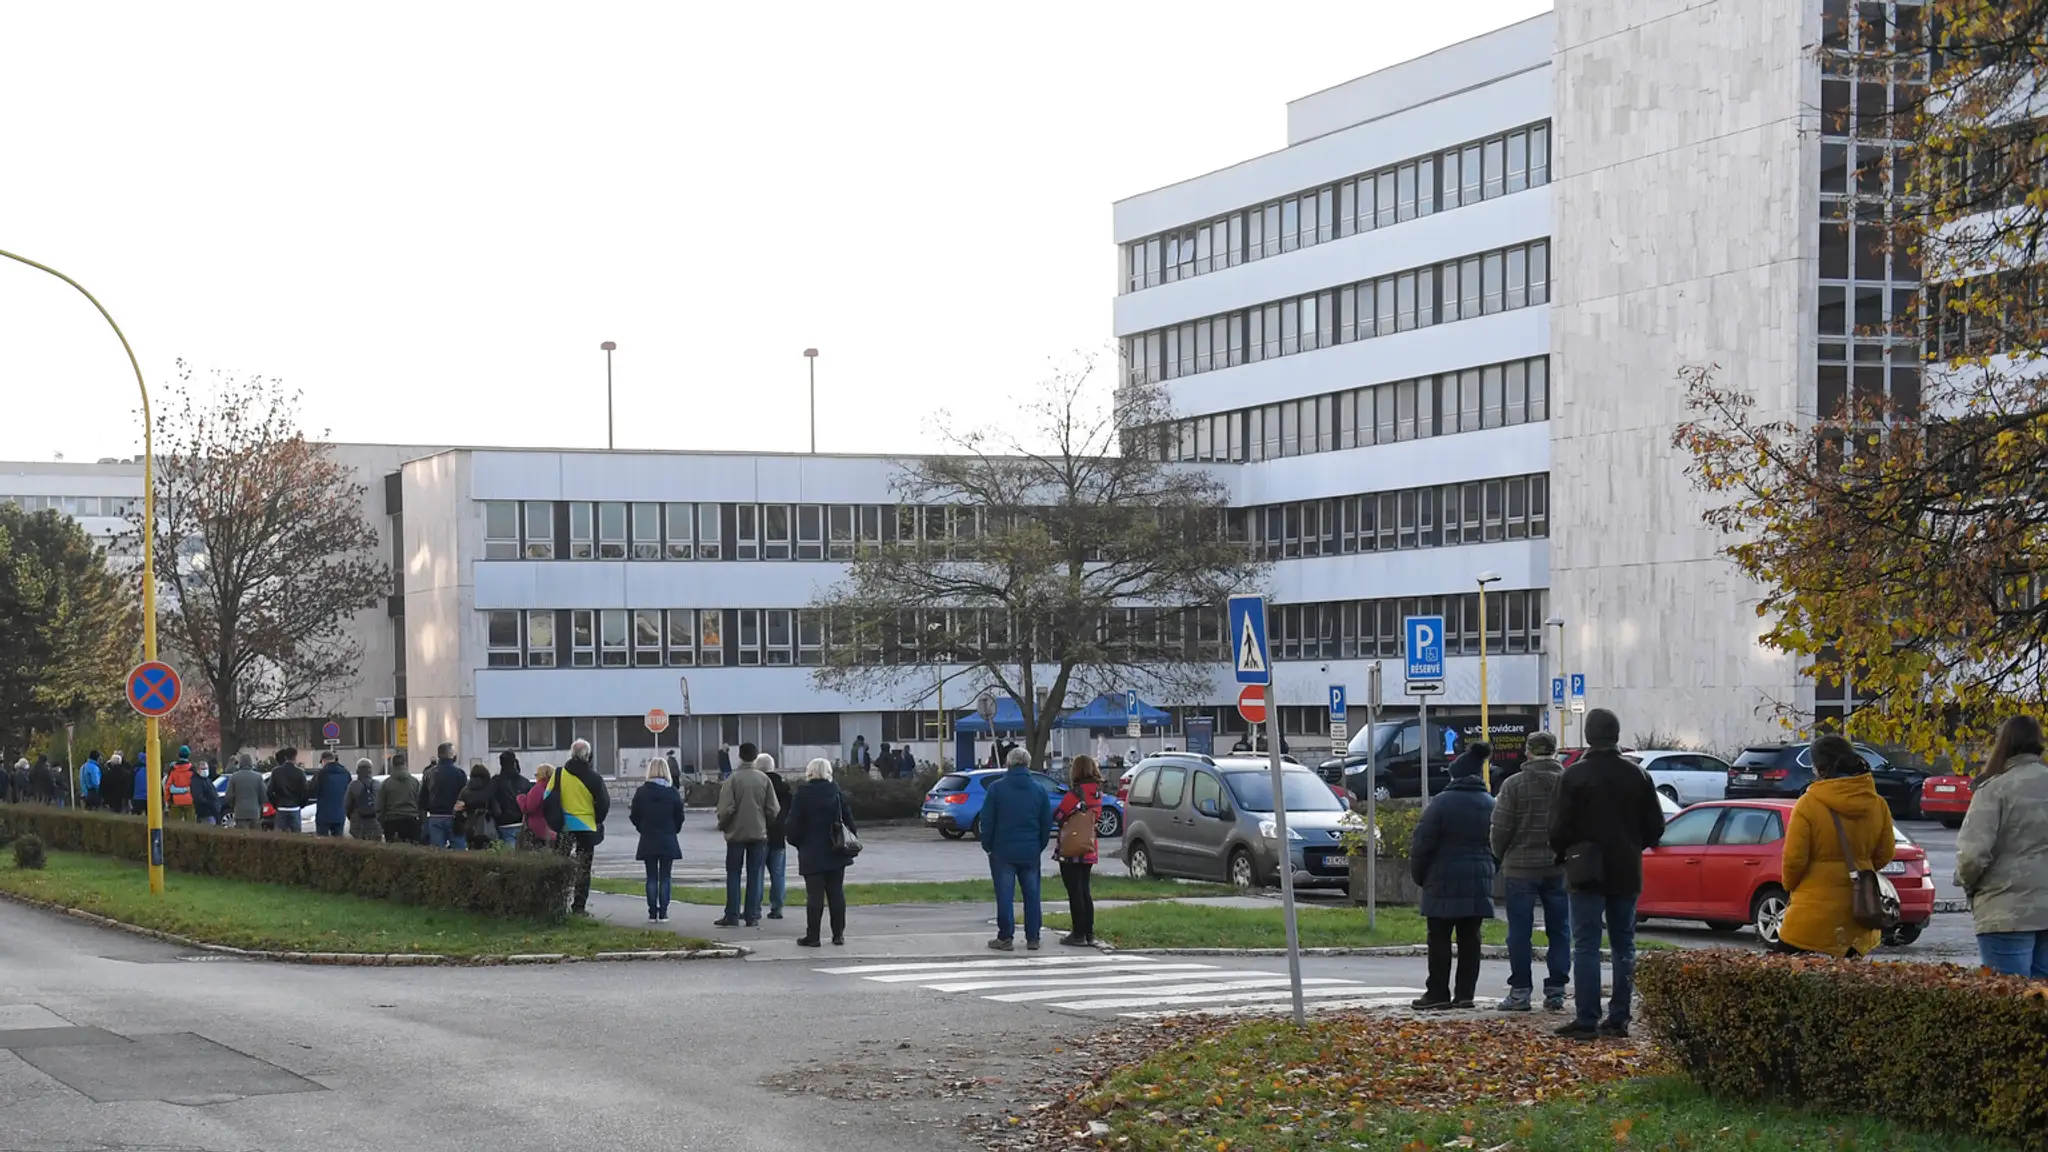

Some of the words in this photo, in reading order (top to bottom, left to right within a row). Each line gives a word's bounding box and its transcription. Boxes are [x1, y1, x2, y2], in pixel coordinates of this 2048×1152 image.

[1416, 624, 1434, 659] P
[1411, 662, 1441, 674] RÉSERVÉ
[1555, 681, 1562, 696] P
[1574, 677, 1581, 692] P
[1129, 692, 1135, 711] P
[1333, 689, 1342, 710] P
[647, 715, 668, 725] STOP
